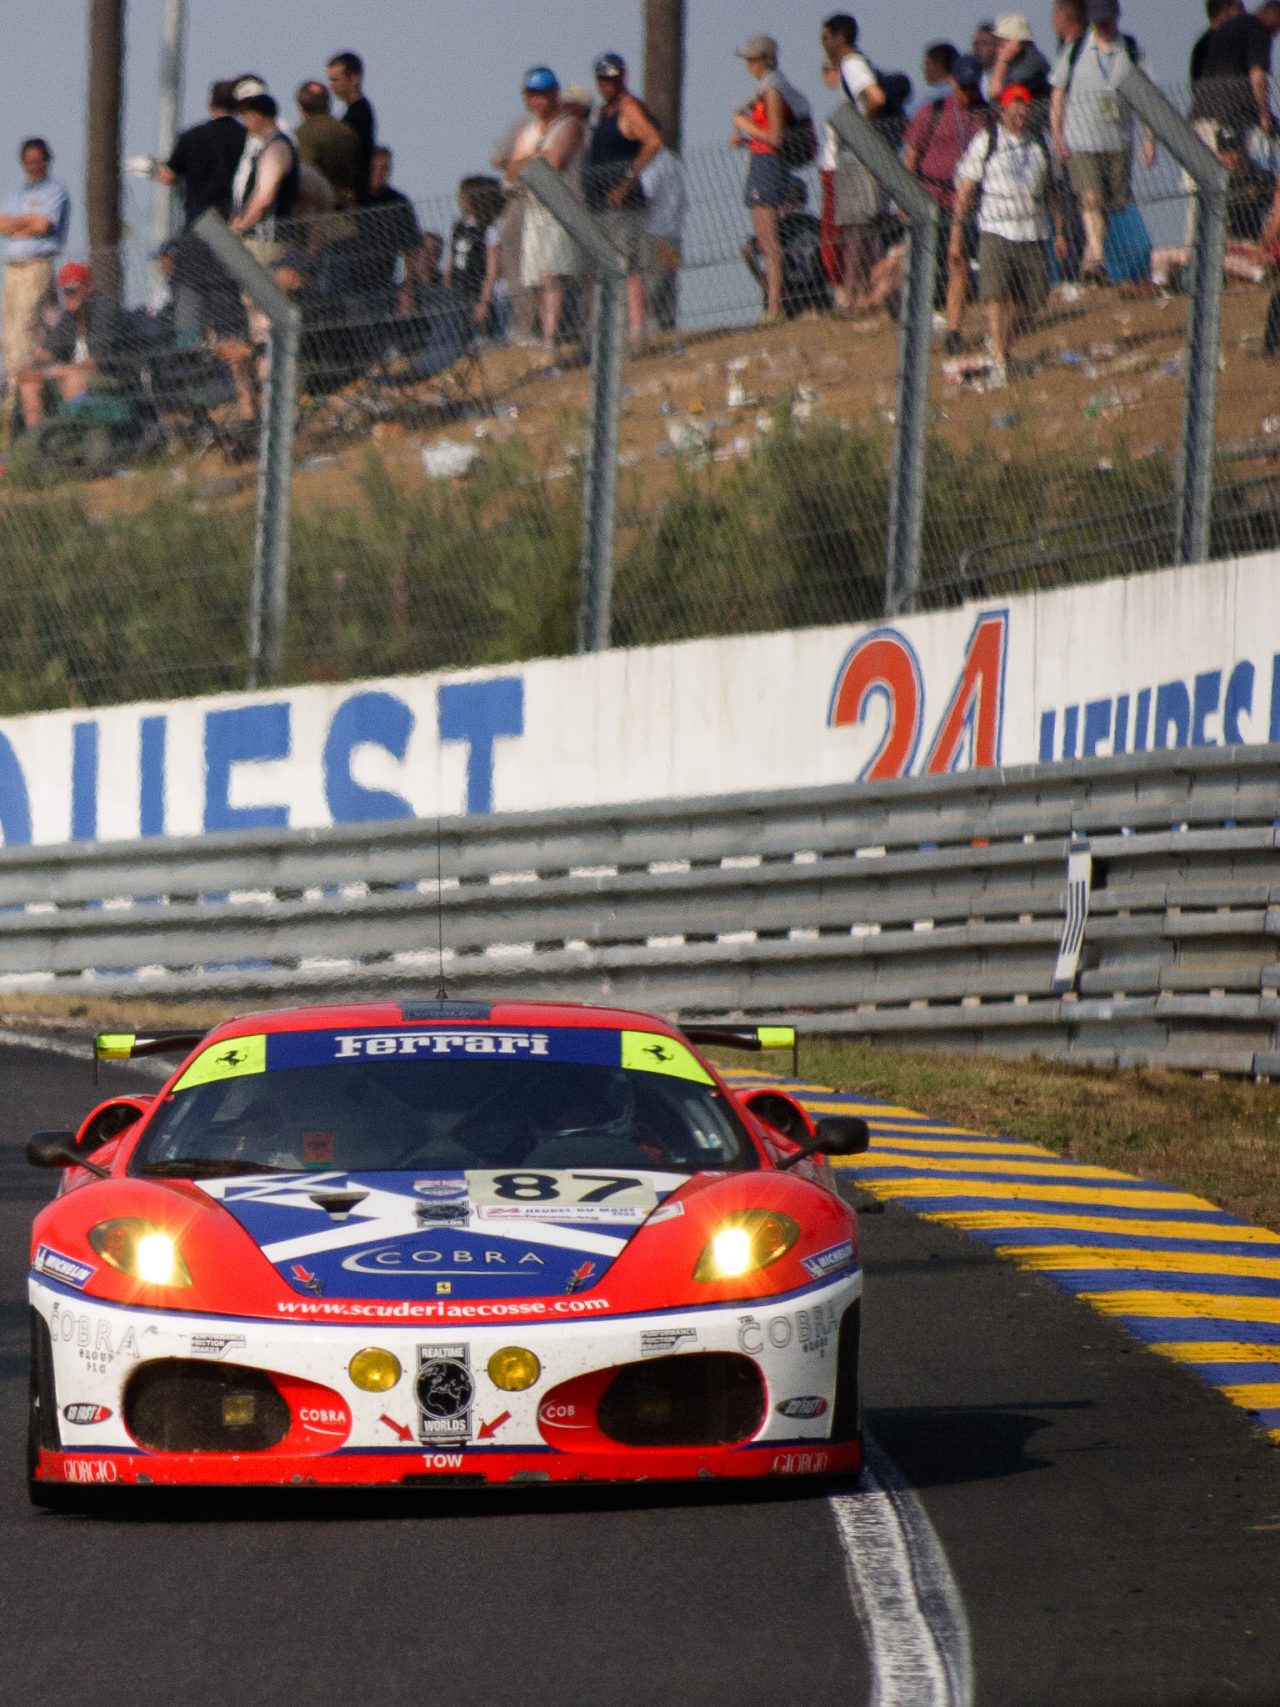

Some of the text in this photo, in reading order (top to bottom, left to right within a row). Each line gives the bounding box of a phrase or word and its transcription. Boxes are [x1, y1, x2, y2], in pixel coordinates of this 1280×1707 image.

[333, 1030, 550, 1058] Ferrari
[492, 1173, 643, 1203] 87
[375, 1250, 545, 1266] COBRA
[44, 1254, 92, 1281] MICHELIN
[277, 1298, 610, 1318] www.scuderiaecosse.com
[50, 1309, 141, 1359] COBRA
[421, 1347, 464, 1358] REALTIME
[299, 1408, 346, 1422] COBRA
[546, 1404, 575, 1418] COB
[424, 1420, 466, 1432] WORLDS
[422, 1453, 463, 1468] TOW
[63, 1457, 117, 1483] GIORGIO
